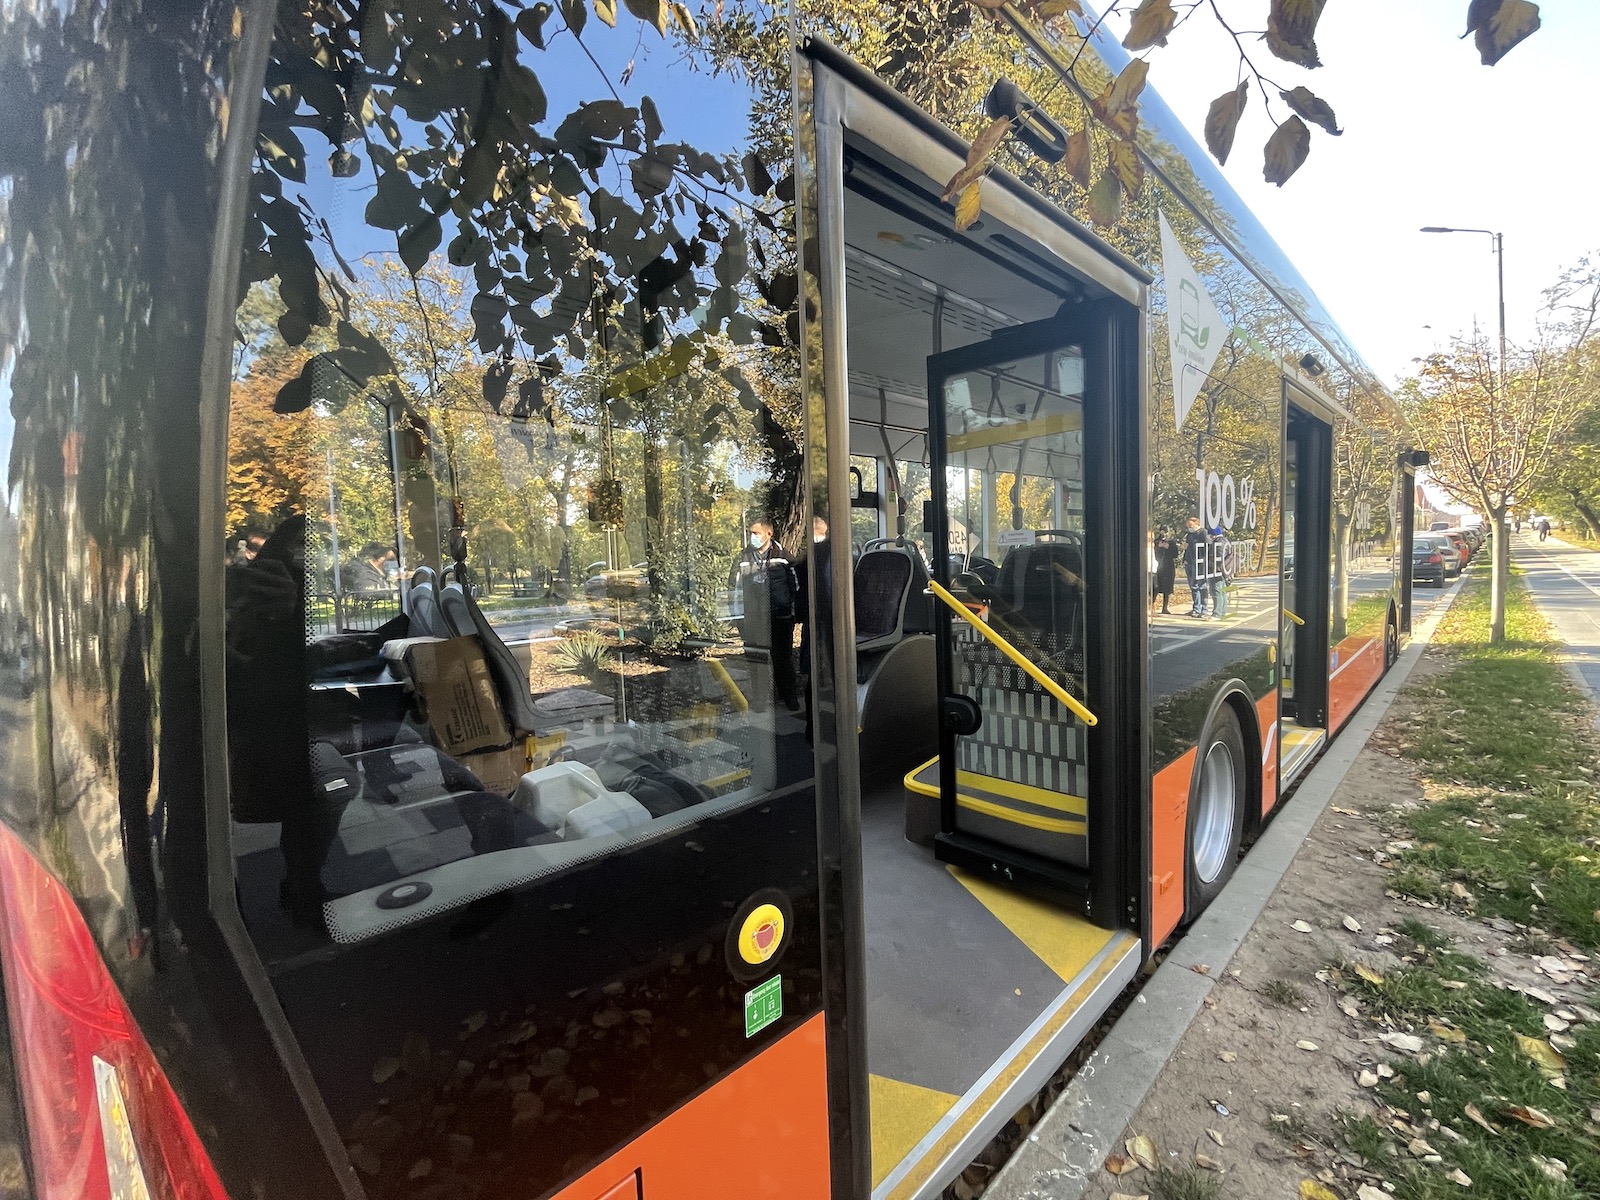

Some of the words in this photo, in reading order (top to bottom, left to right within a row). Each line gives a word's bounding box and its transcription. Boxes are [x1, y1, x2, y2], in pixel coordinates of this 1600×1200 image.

[1196, 468, 1235, 529] 100
[1241, 474, 1256, 529] %
[1195, 539, 1258, 580] ELECTRIC
